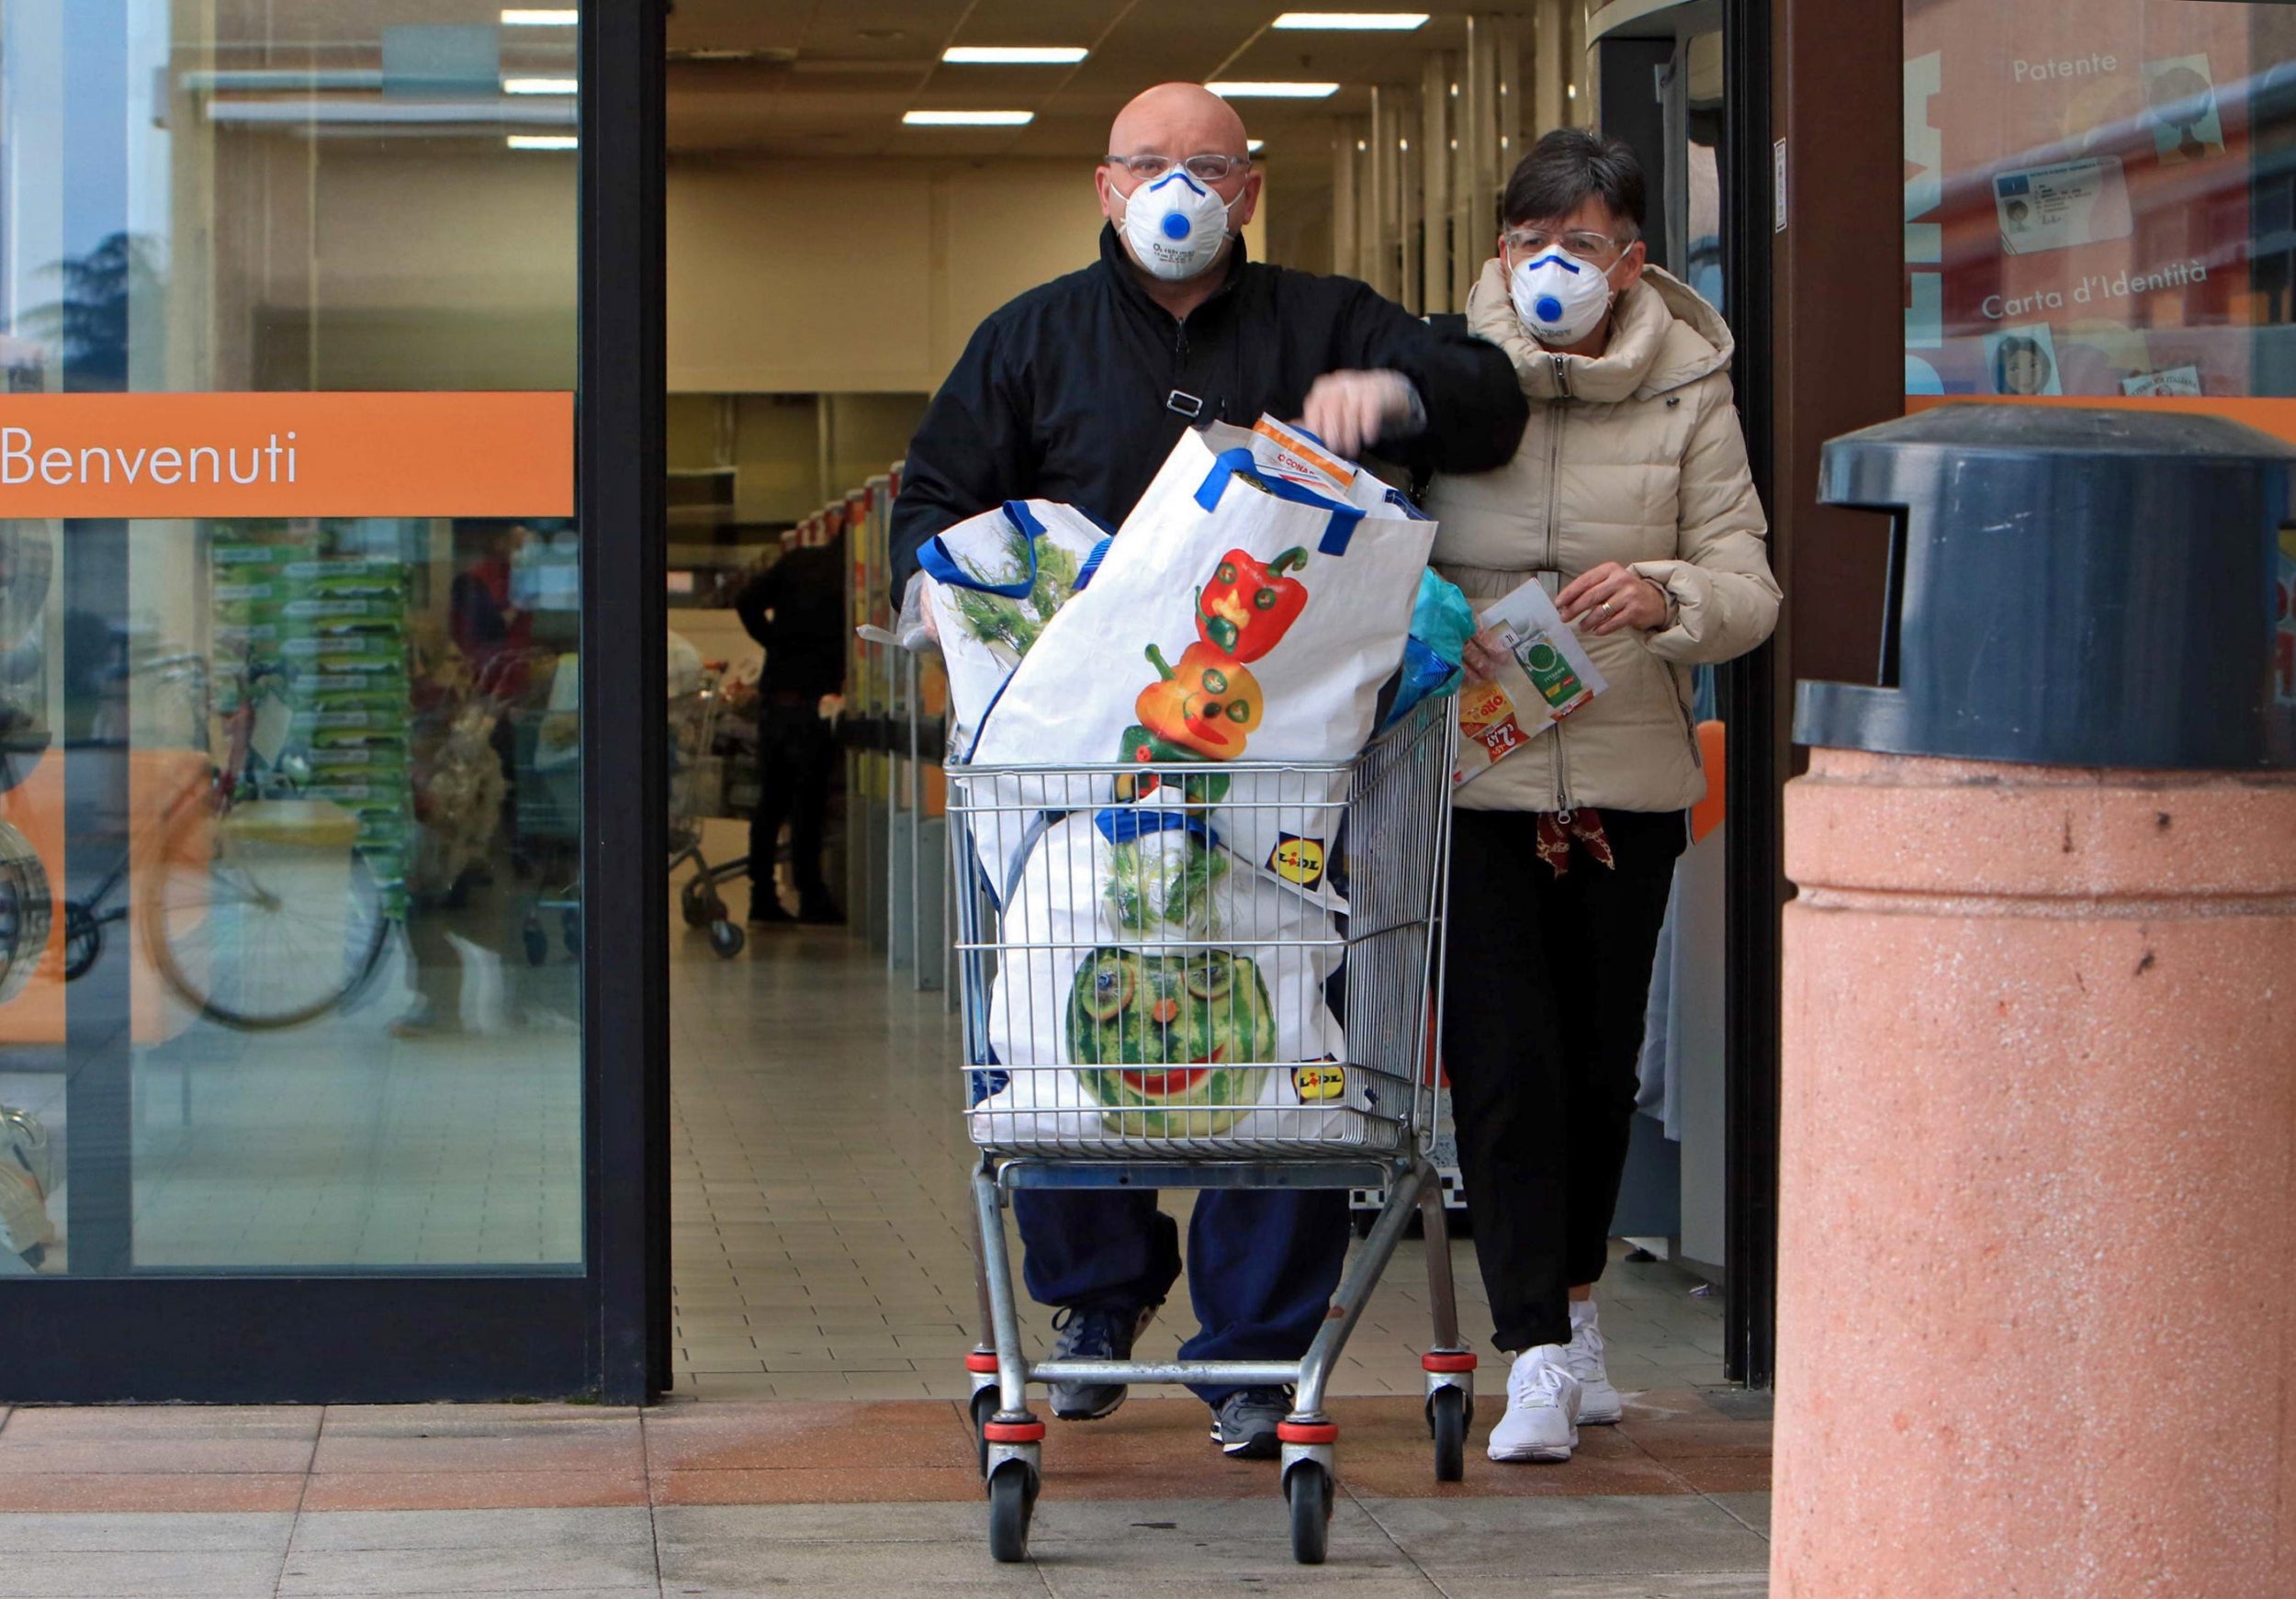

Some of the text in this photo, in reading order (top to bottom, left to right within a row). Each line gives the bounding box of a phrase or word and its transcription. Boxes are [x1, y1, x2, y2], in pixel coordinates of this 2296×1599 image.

[2013, 52, 2117, 83] Patente
[1982, 260, 2208, 319] Carta d'Identità
[1, 427, 297, 484] Benvenuti
[1286, 458, 1314, 474] CONA
[1277, 852, 1319, 870] LIDL
[1299, 1072, 1342, 1088] LIDL
